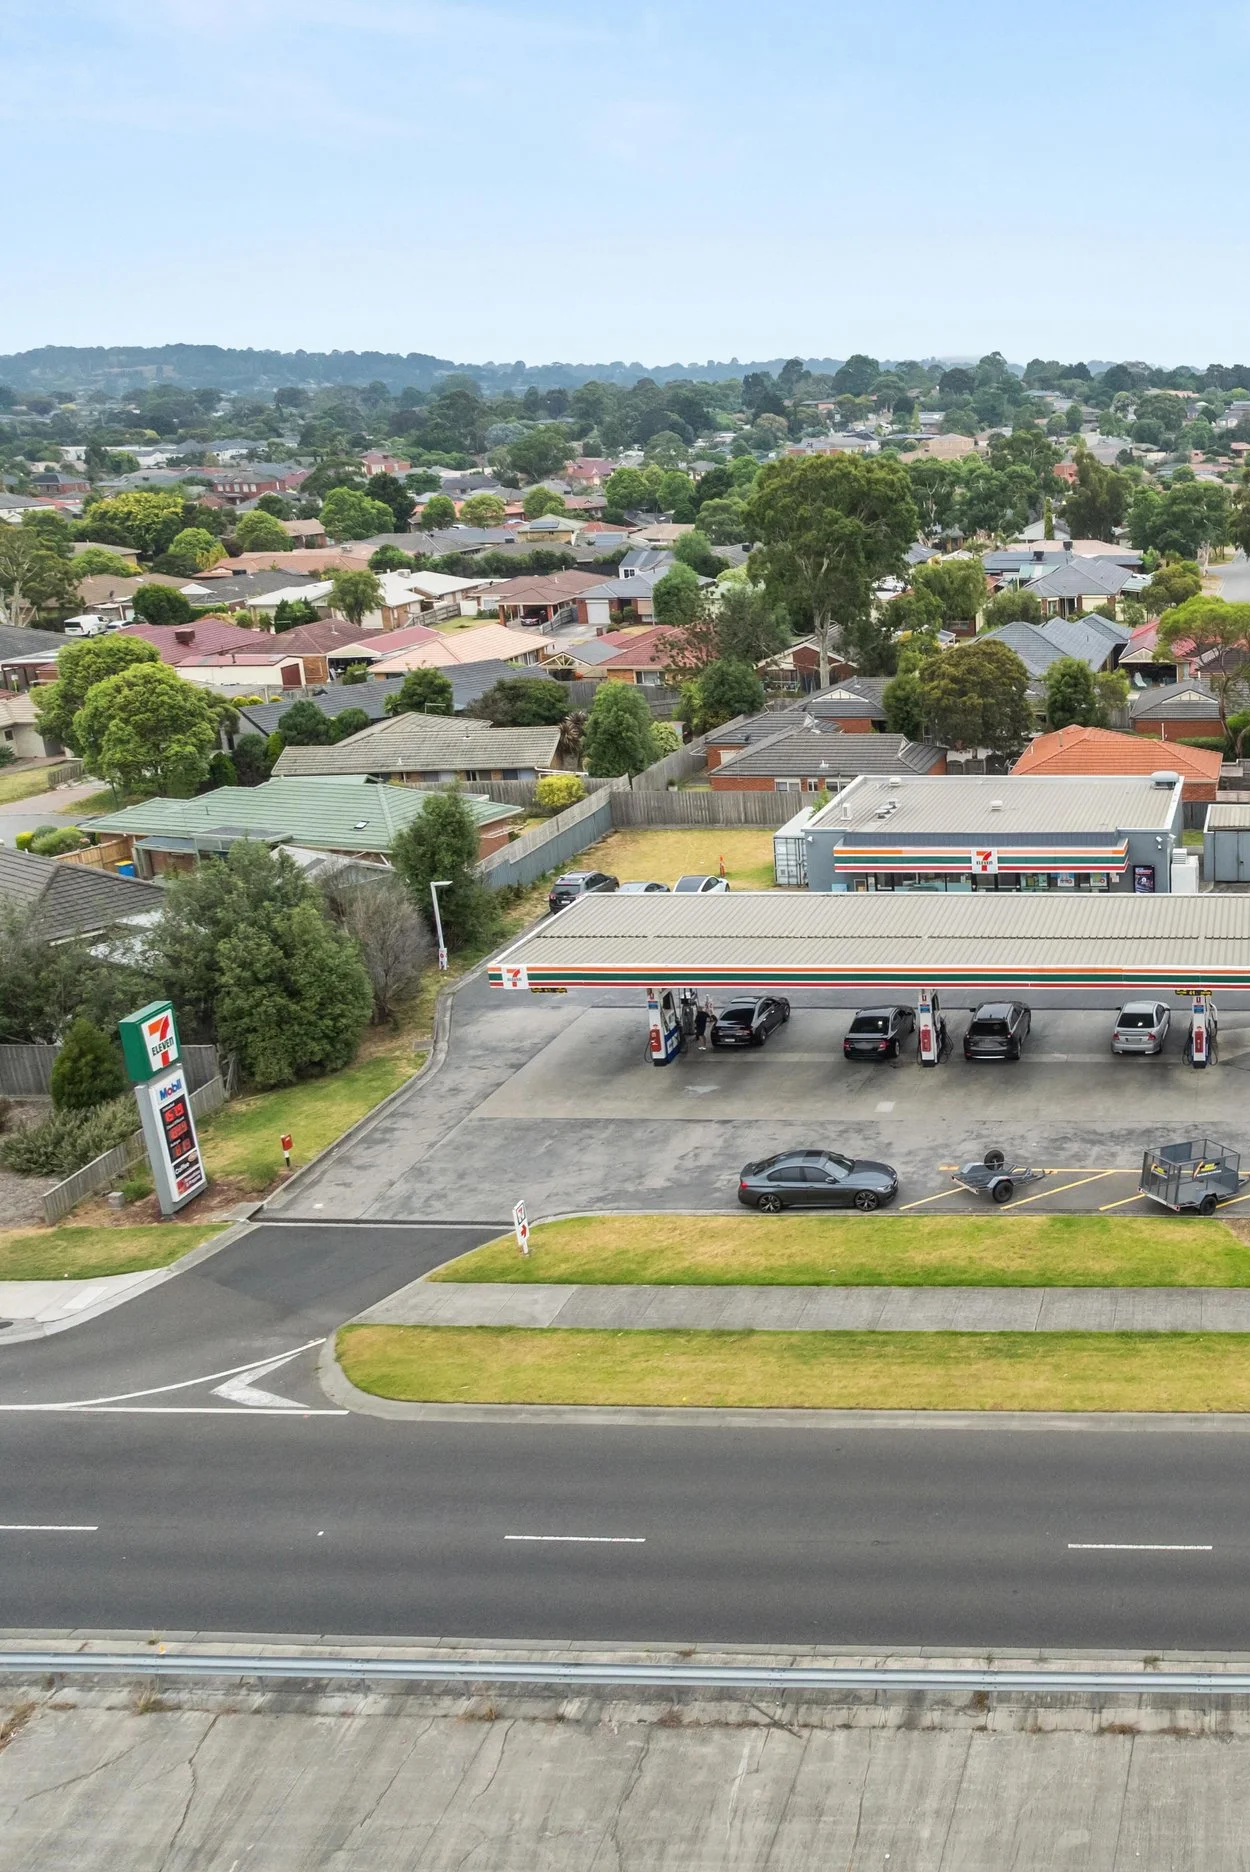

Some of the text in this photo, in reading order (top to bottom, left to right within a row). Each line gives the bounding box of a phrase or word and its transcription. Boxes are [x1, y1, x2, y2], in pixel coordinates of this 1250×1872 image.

[976, 851, 992, 871] 7
[506, 969, 521, 987] 7
[148, 1015, 170, 1068] 7
[160, 1078, 182, 1100] Mobil
